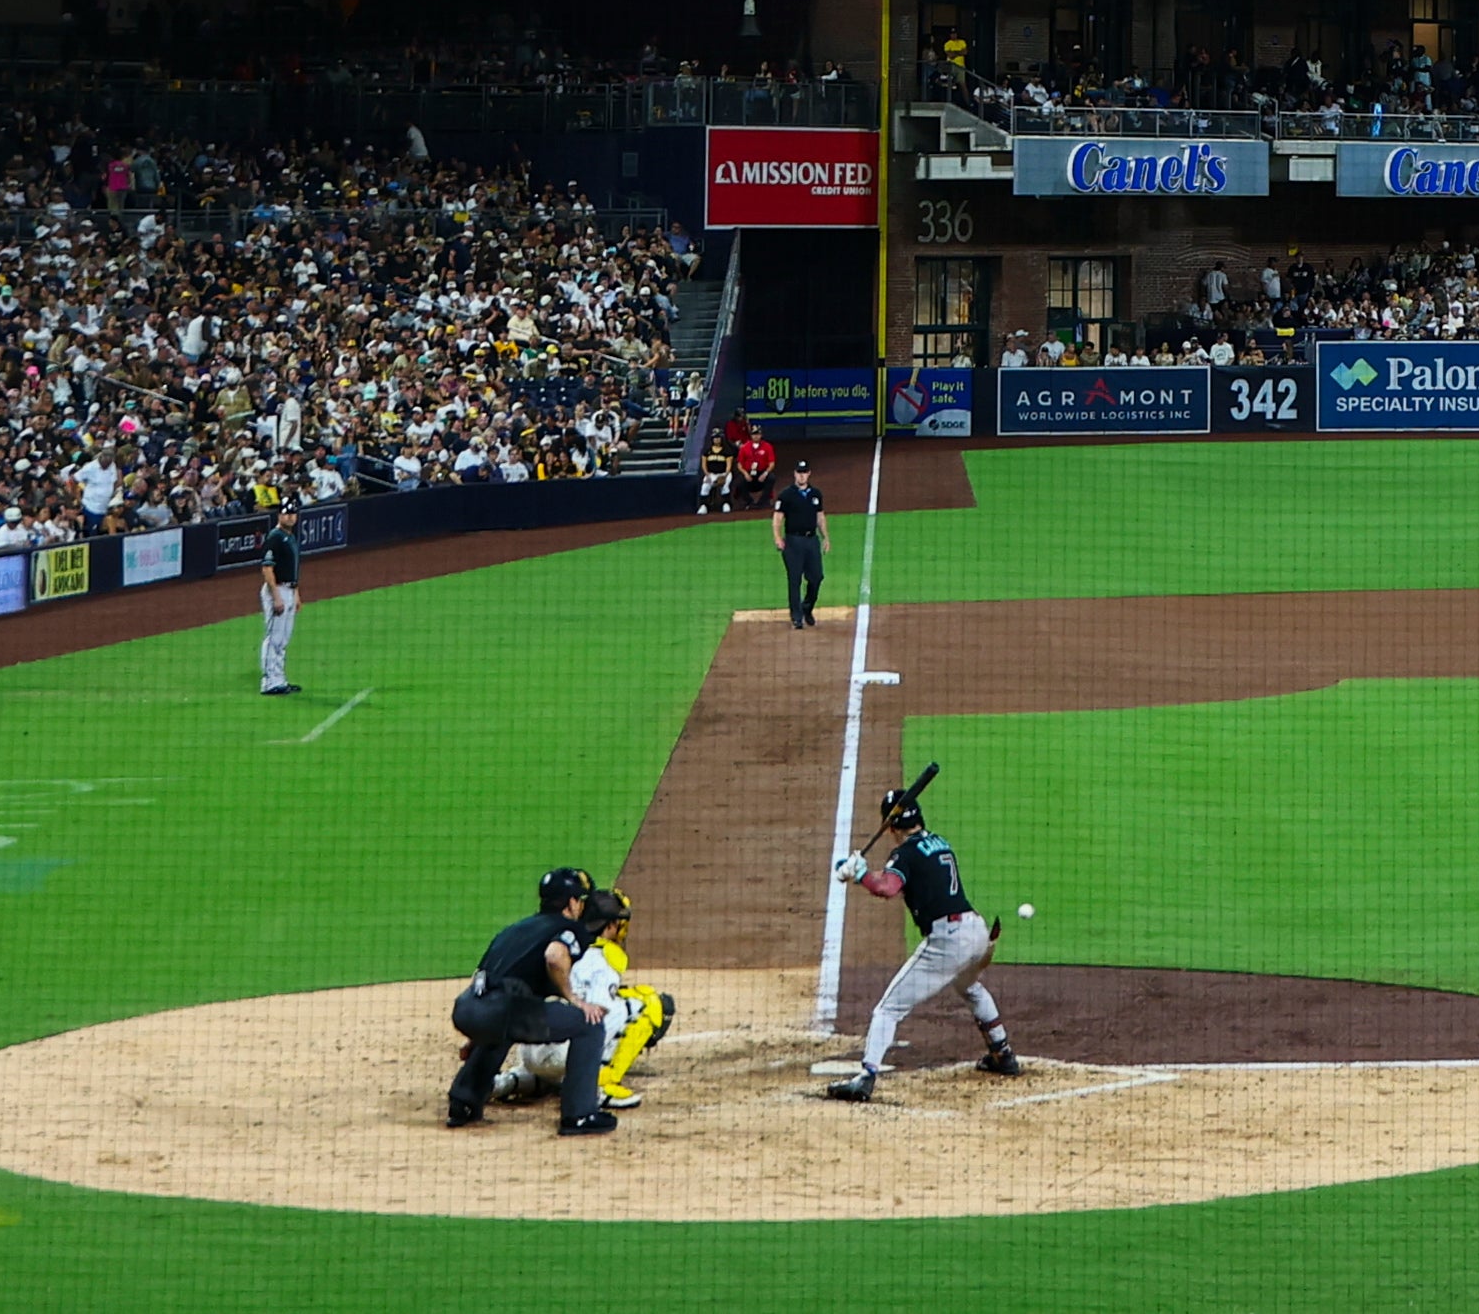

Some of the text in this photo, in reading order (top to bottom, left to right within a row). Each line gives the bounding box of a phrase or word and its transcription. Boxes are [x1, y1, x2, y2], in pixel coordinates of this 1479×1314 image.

[741, 161, 872, 186] MISSION FED
[1067, 141, 1228, 193] Canel's
[811, 185, 872, 196] CREDIT UNION
[917, 199, 974, 243] 336
[767, 378, 790, 400] 811
[794, 385, 828, 399] before
[830, 387, 849, 400] you
[851, 384, 870, 400] dig.
[932, 381, 953, 392] Play
[932, 394, 957, 404] safe.
[1229, 378, 1299, 420] 342
[1336, 396, 1436, 413] SPECIALTY
[1018, 409, 1191, 422] WORLDWIDE LOGISTICS INC
[938, 853, 959, 896] 7
